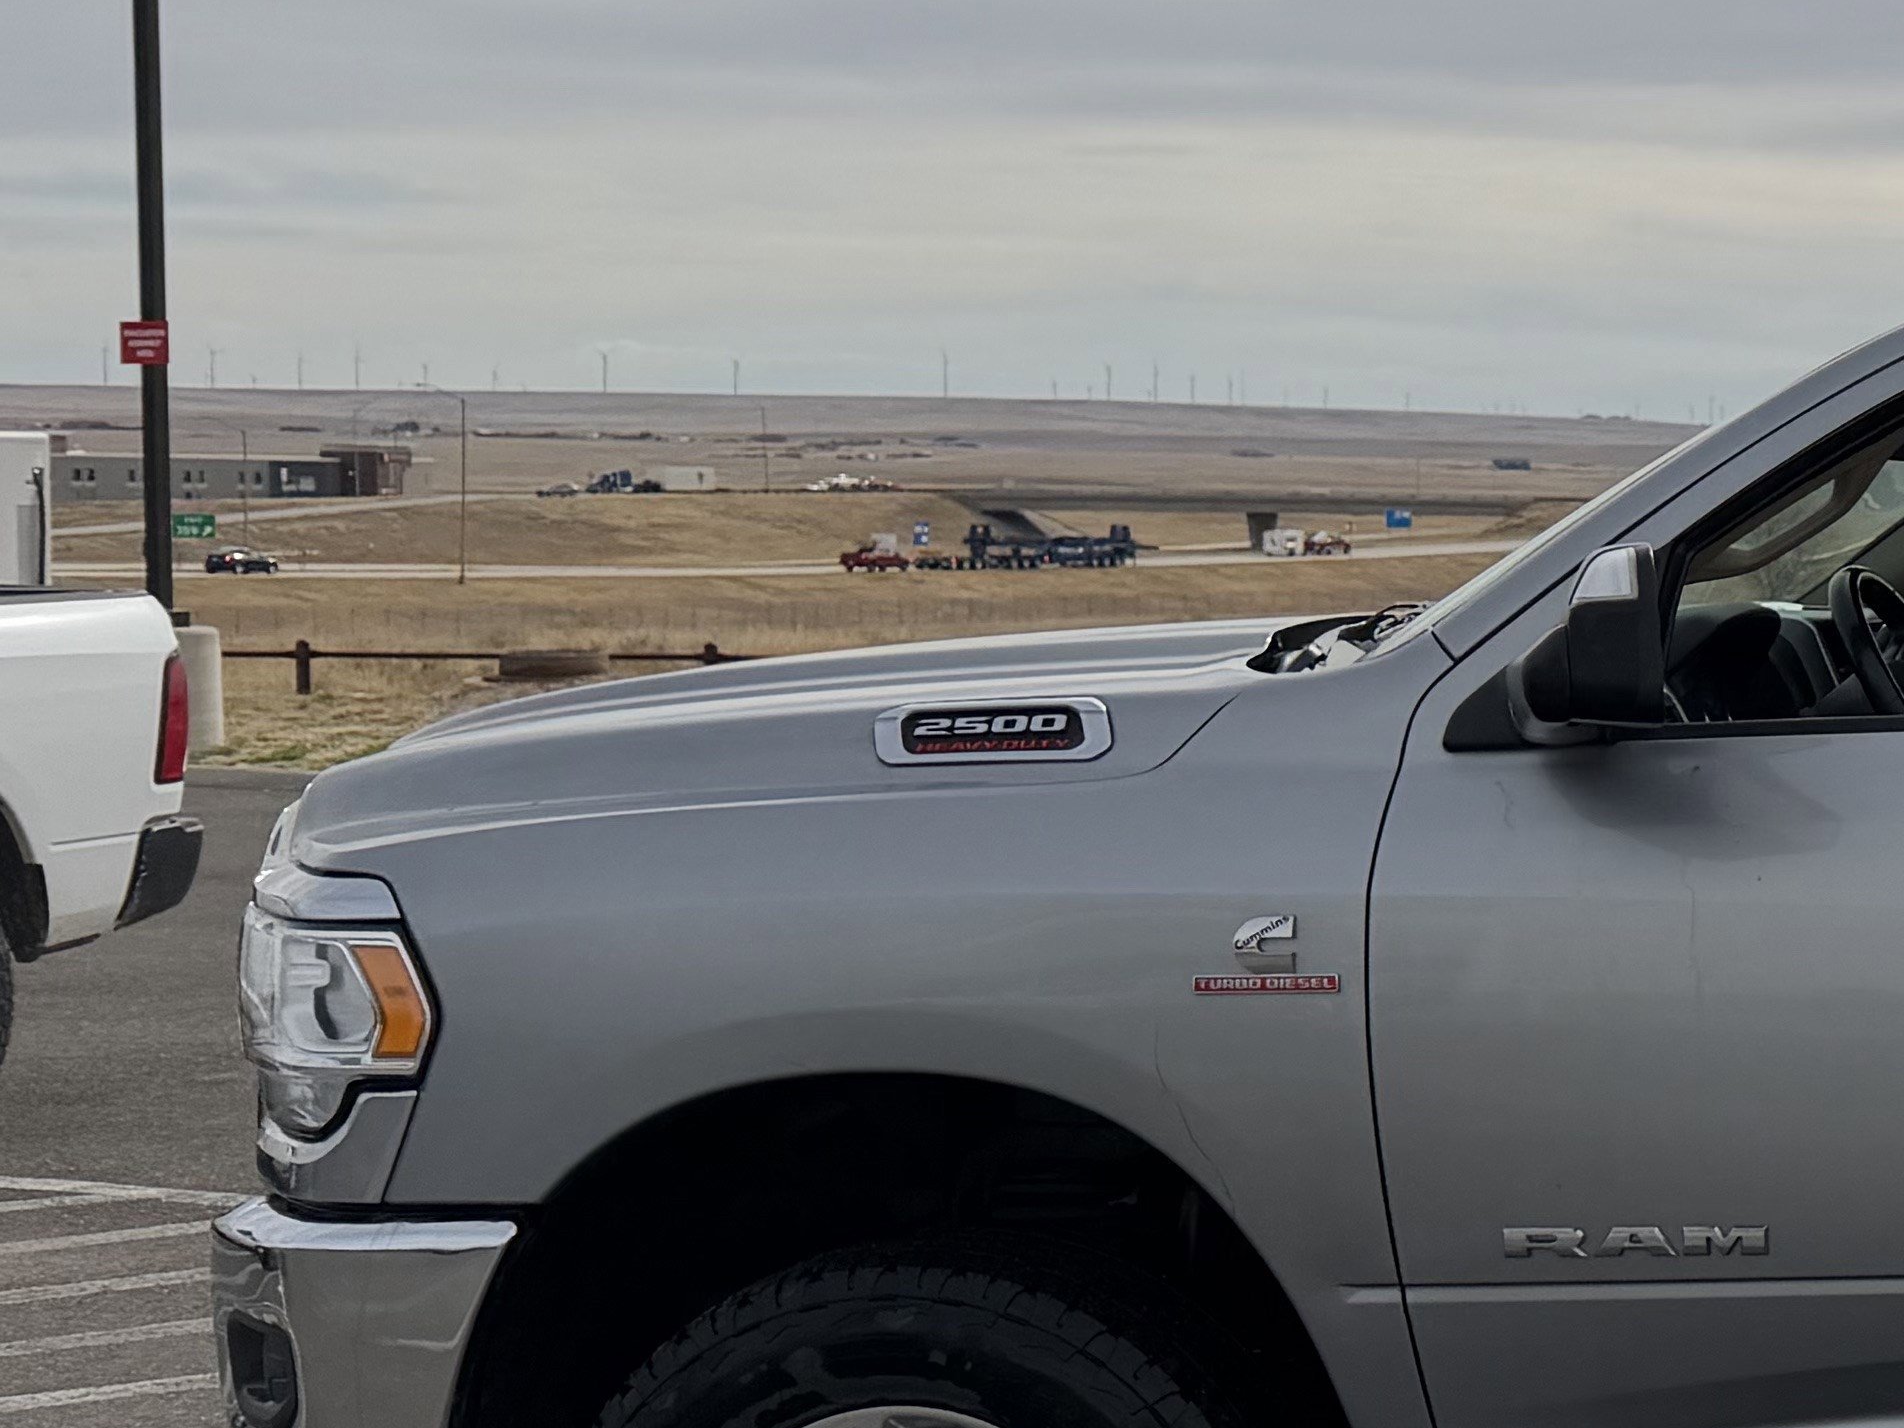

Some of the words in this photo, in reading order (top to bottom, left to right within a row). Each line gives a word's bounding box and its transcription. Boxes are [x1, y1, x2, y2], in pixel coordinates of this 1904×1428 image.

[913, 713, 1068, 736] 2500
[1234, 915, 1290, 950] Cummins
[1198, 977, 1262, 989] TURBO
[1265, 977, 1336, 989] DIESEL
[1503, 1226, 1768, 1257] RAM
